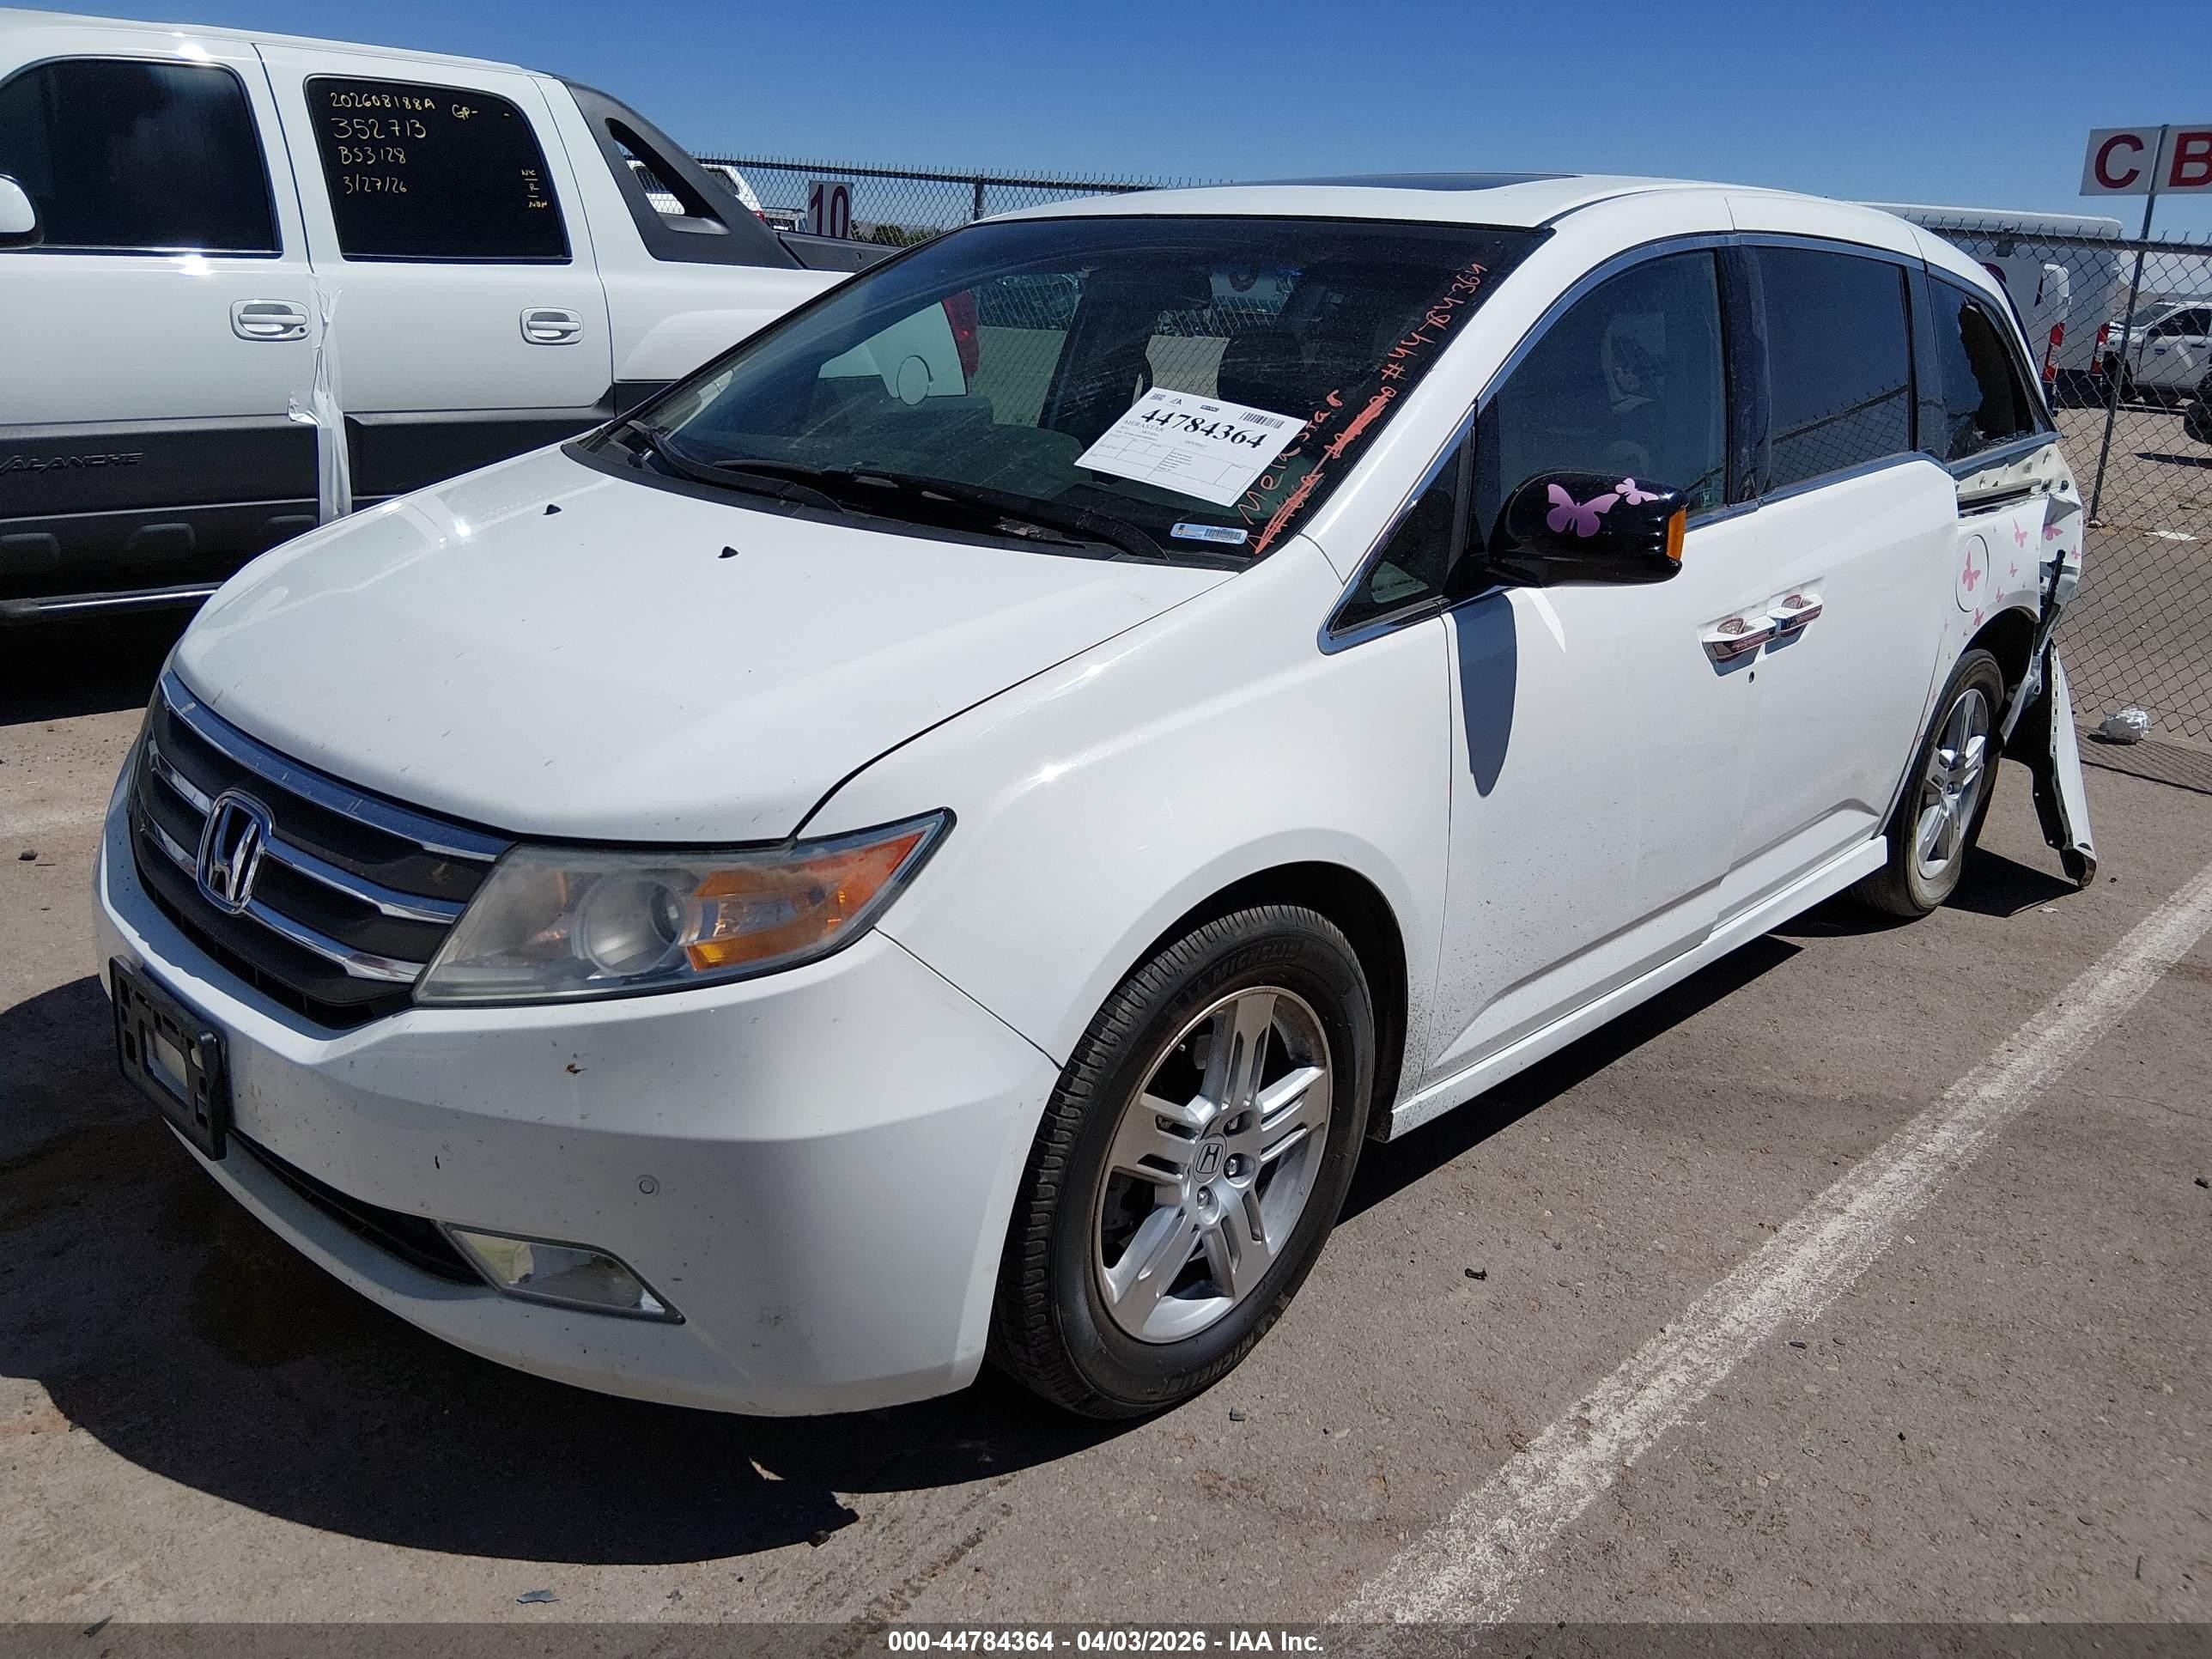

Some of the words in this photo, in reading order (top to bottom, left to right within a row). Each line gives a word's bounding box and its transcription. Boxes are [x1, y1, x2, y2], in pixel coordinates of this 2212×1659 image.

[338, 146, 406, 165] BS3128
[2094, 134, 2144, 189] C
[811, 185, 848, 239] 10
[1140, 409, 1268, 448] 44784364
